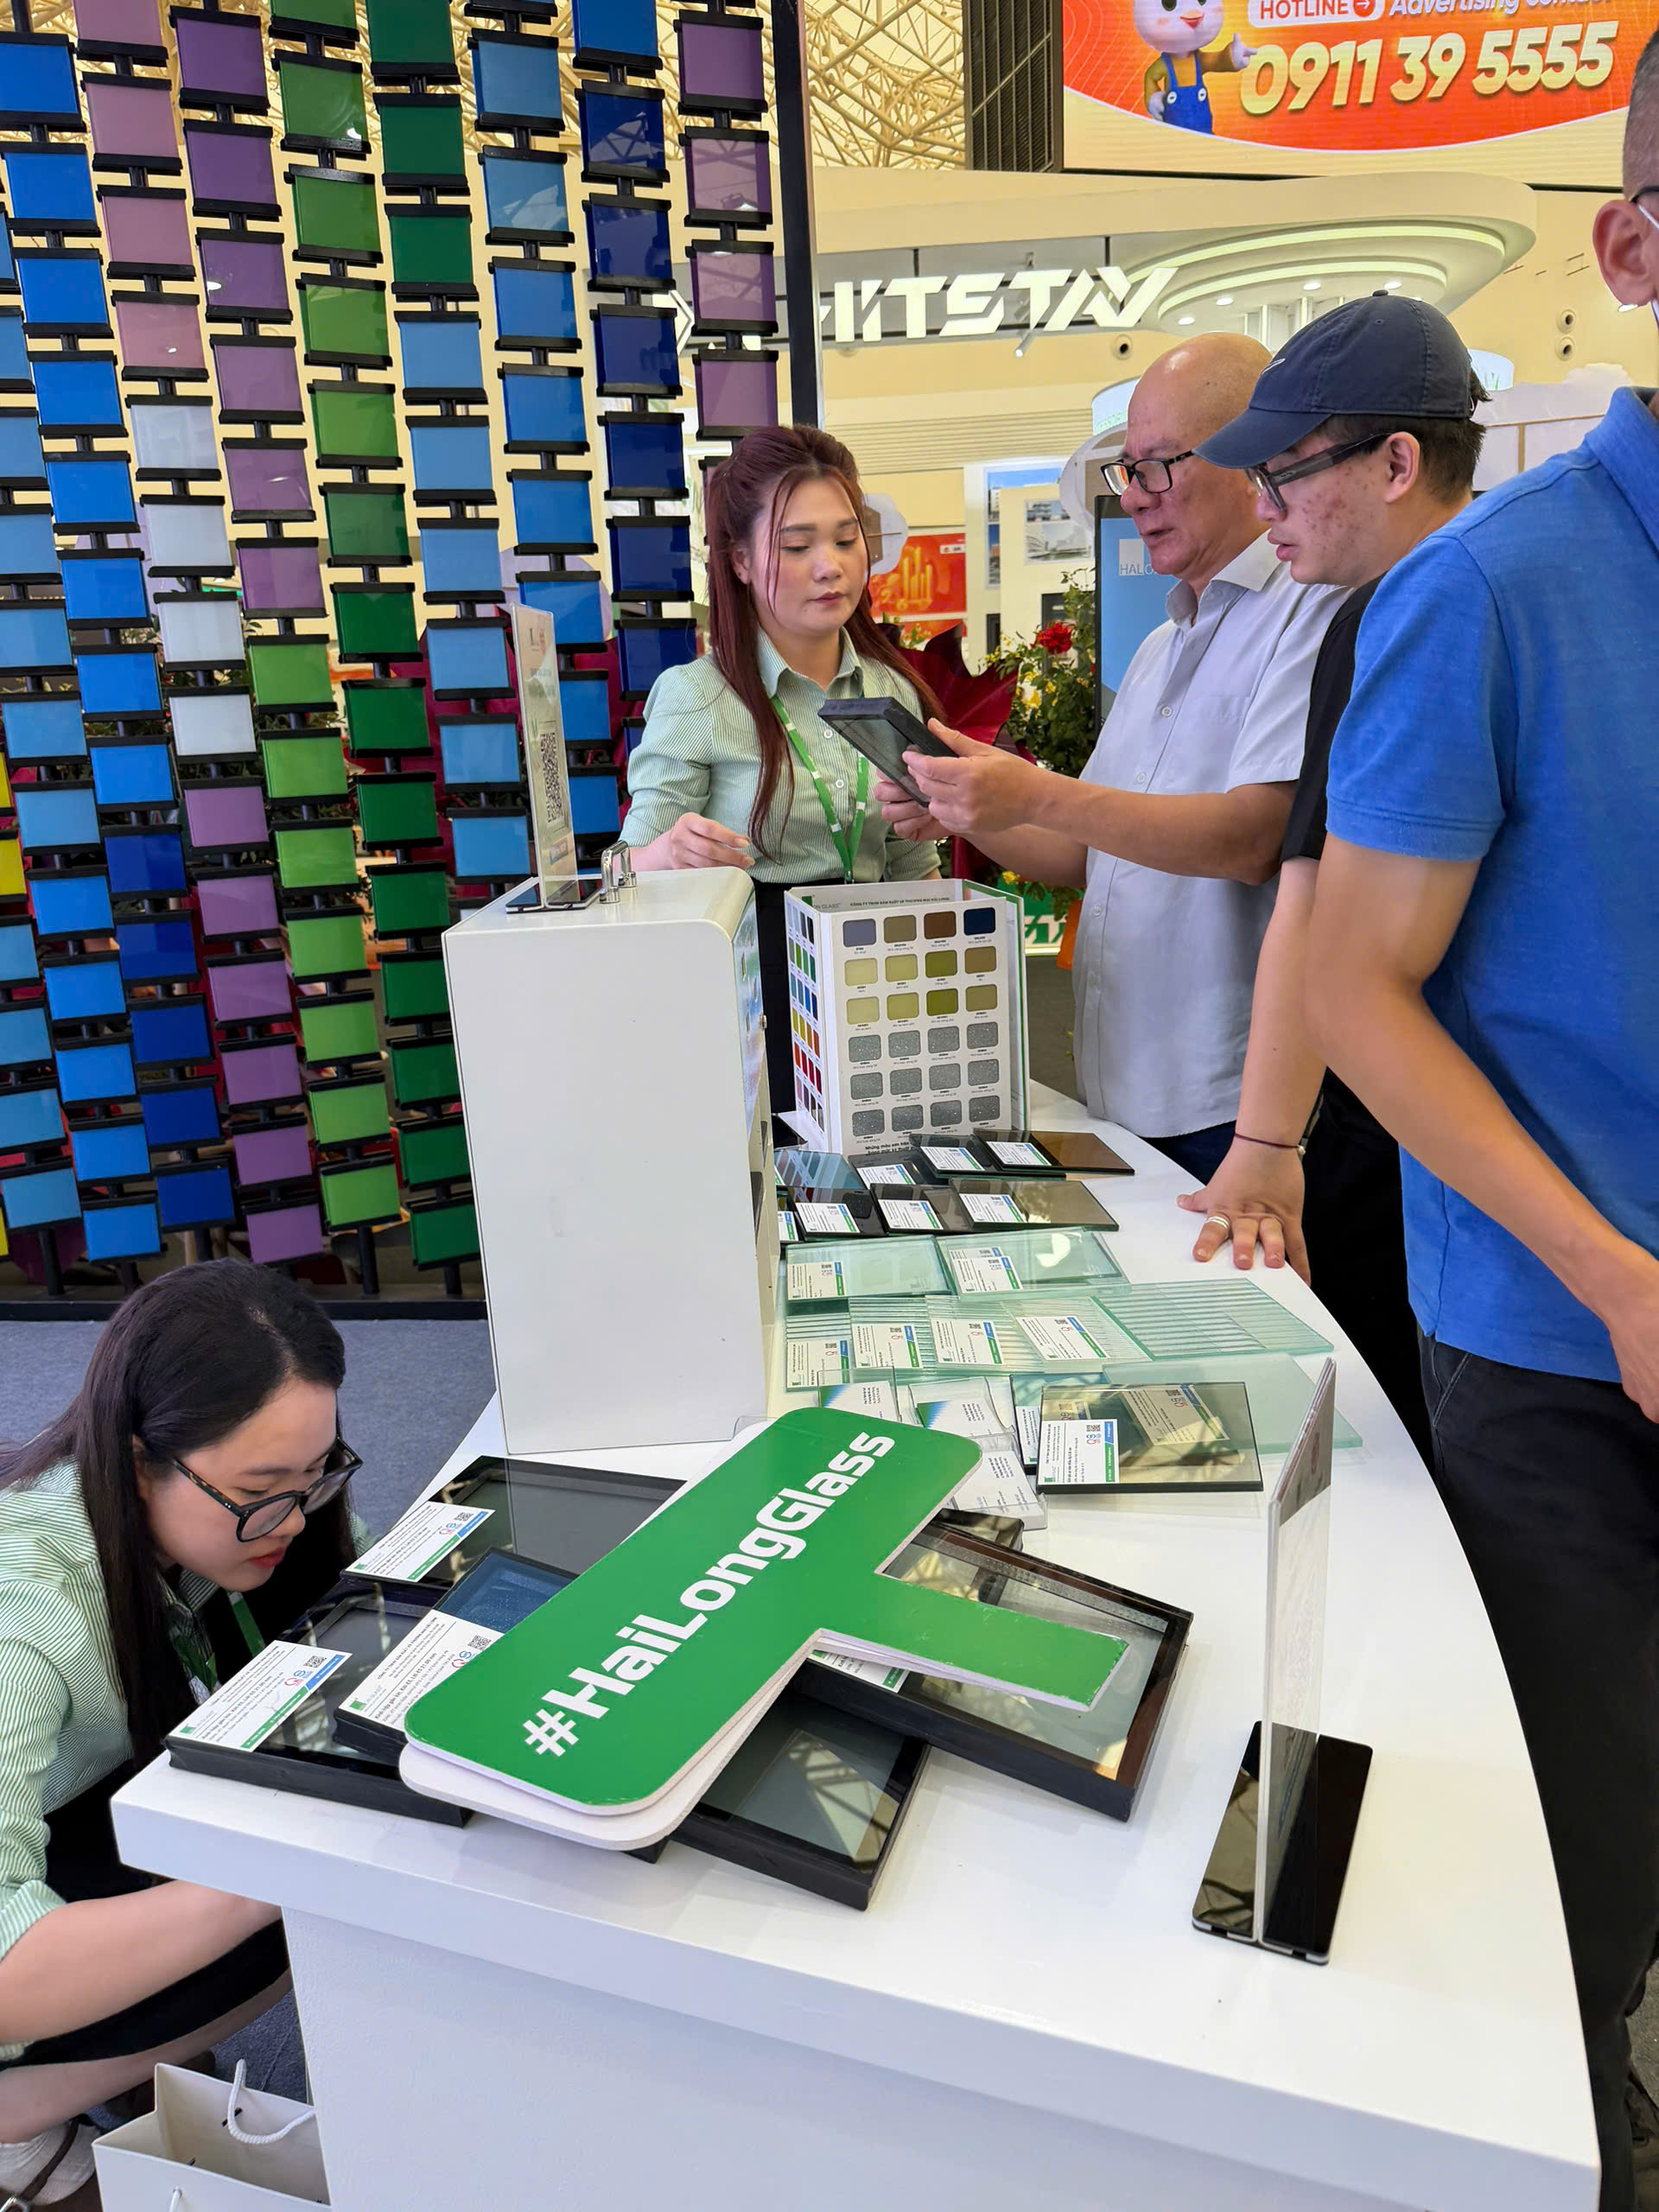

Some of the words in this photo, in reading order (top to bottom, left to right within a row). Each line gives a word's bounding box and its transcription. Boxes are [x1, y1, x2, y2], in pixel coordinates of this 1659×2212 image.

[1260, 0, 1350, 20] HOTLINE
[1241, 39, 1382, 115] 0911
[1390, 32, 1465, 102] 39
[1472, 21, 1618, 94] 5555
[523, 1432, 895, 1756] #HaiLongGlass
